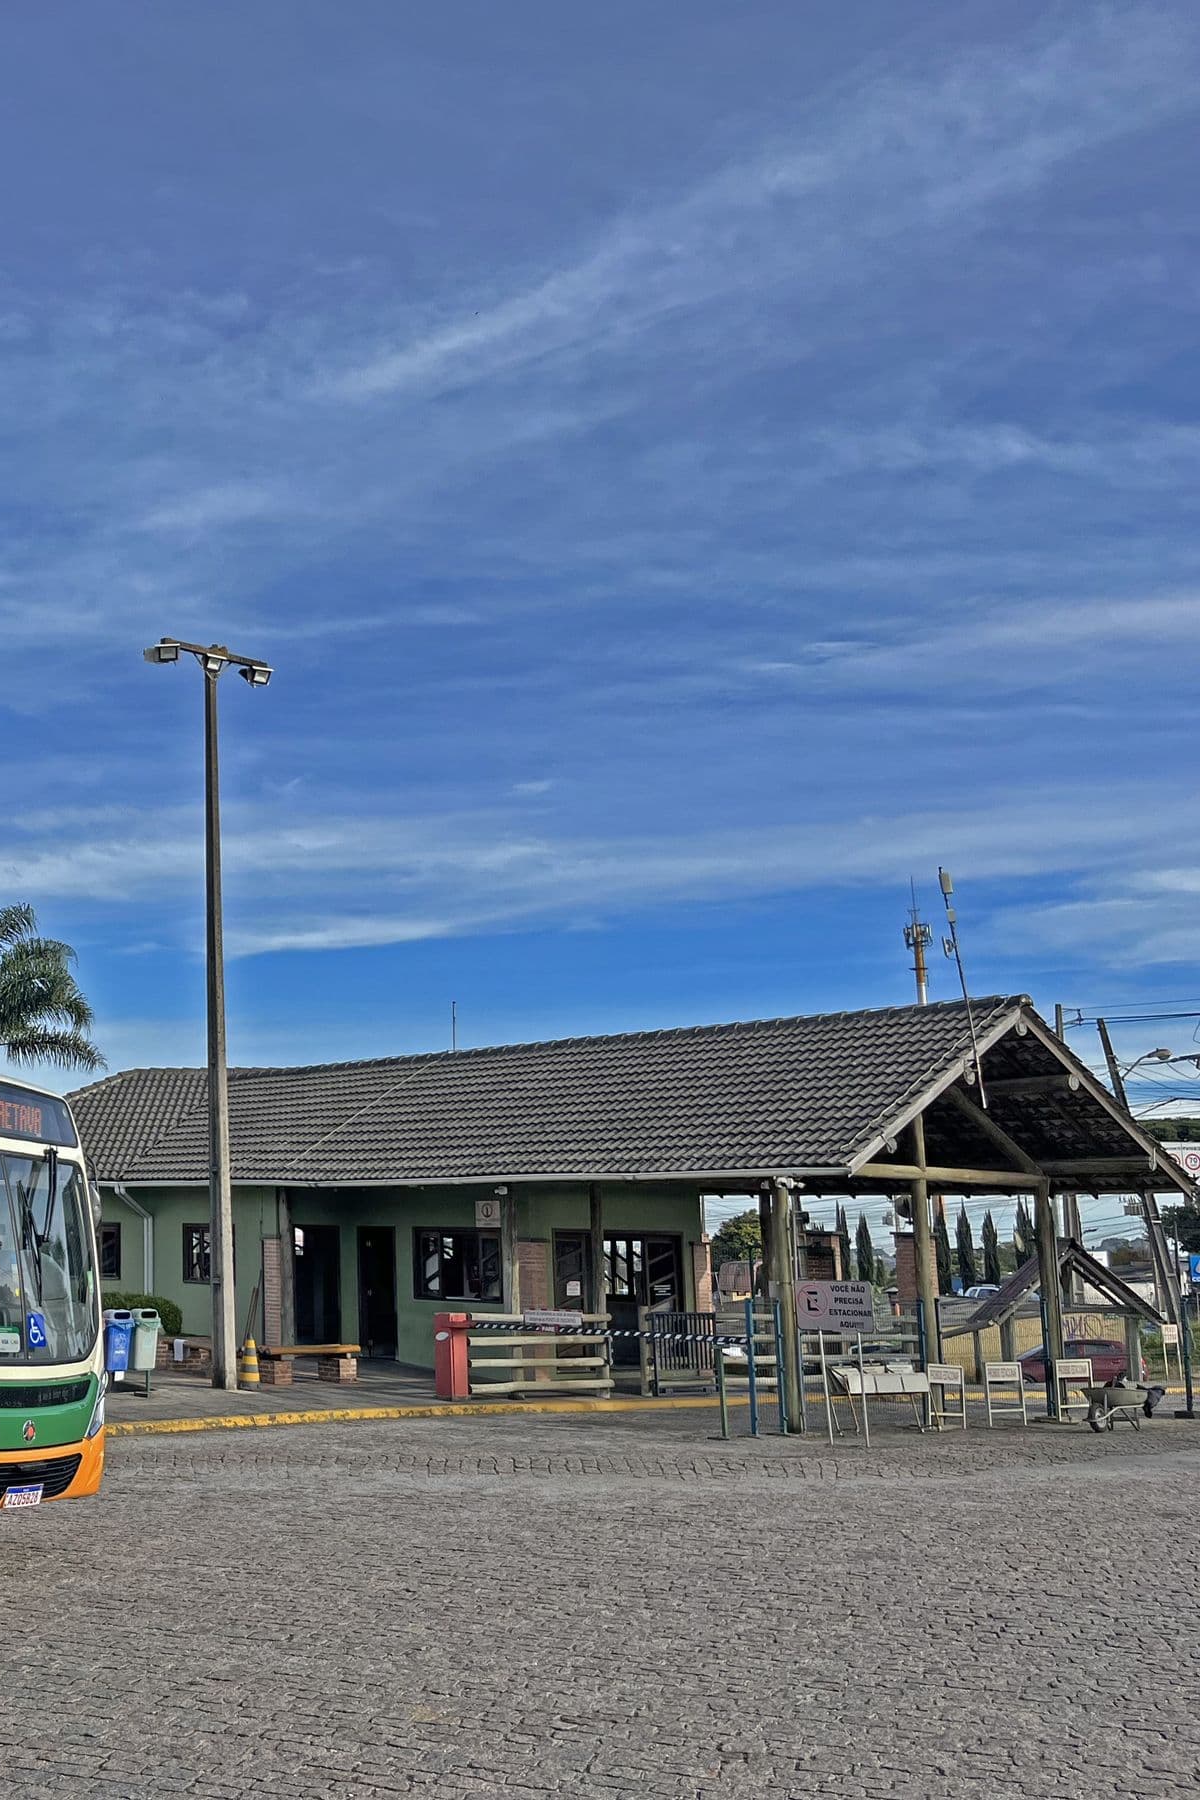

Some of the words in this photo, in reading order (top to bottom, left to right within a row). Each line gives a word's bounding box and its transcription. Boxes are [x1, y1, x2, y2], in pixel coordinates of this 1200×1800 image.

[850, 1284, 865, 1293] NÃO
[834, 1297, 864, 1305] PRECISA
[829, 1308, 872, 1317] ESTACIONAR
